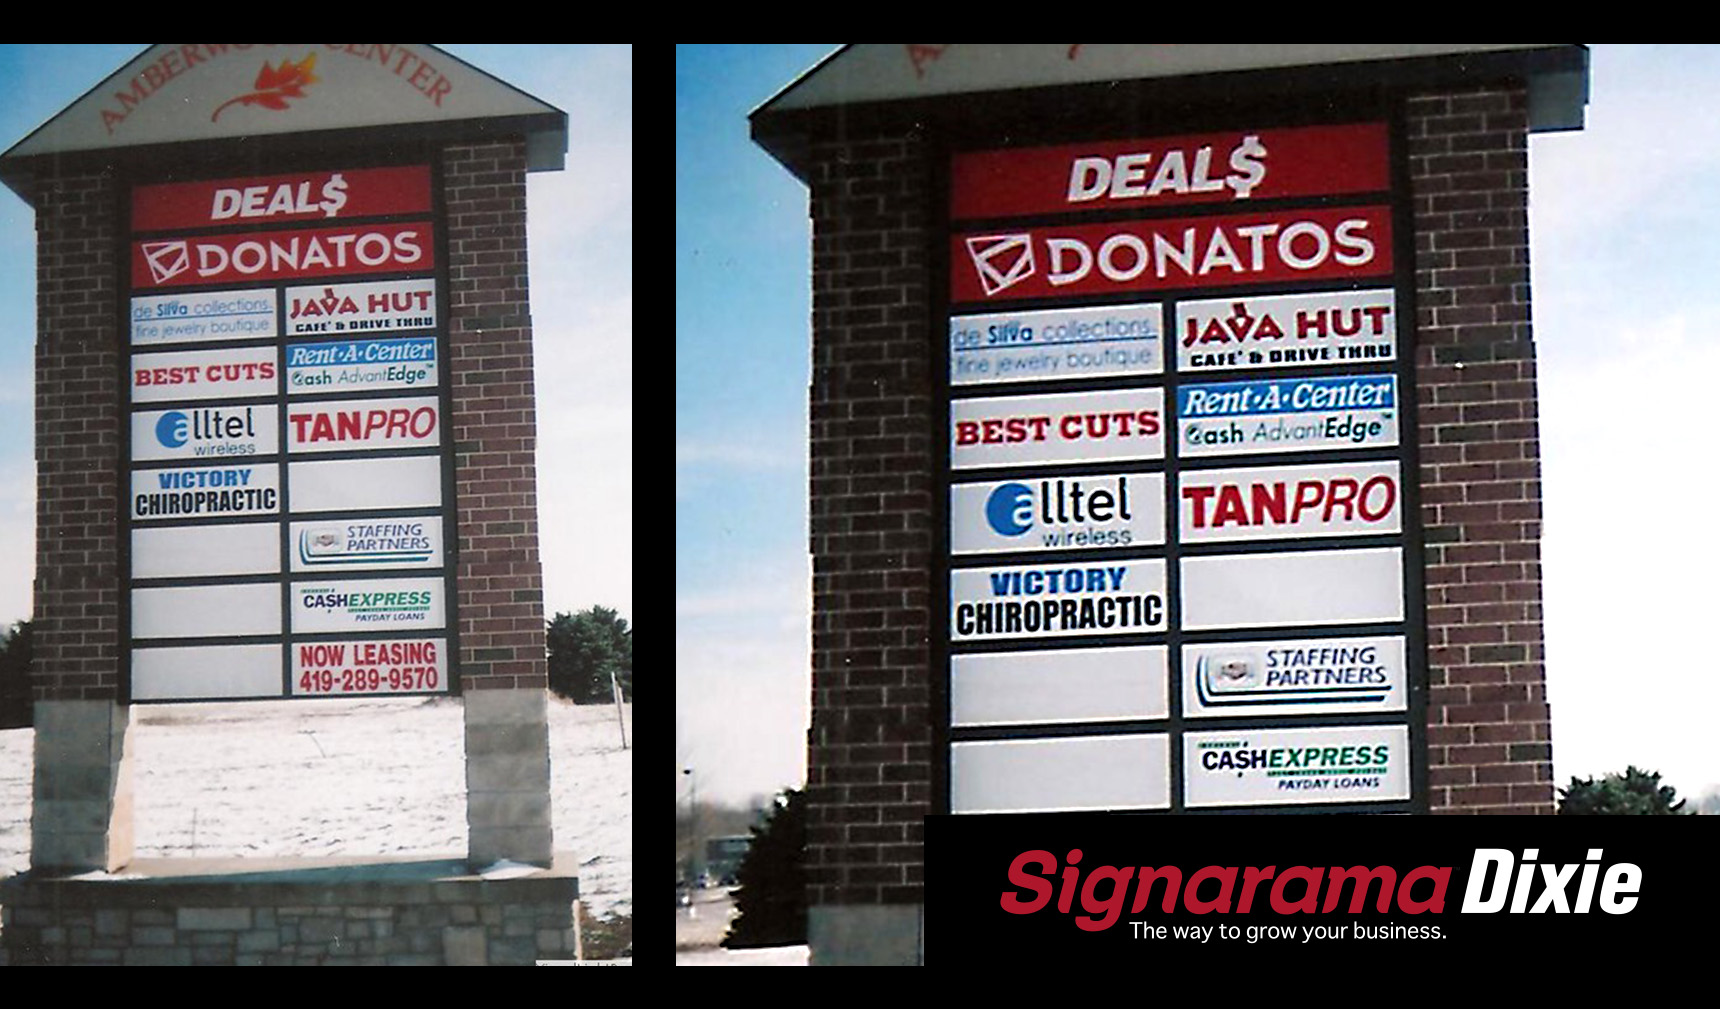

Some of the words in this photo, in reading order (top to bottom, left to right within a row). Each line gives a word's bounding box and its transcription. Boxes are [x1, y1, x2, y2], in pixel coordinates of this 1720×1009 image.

[325, 44, 452, 107] ENTER
[1068, 136, 1267, 201] DEAL$
[211, 174, 348, 219] DEAL$
[197, 231, 422, 276] DONATOS
[1046, 218, 1375, 286] DONATOS
[134, 305, 152, 318] de
[157, 302, 188, 317] Silva
[290, 288, 359, 319] JAVA
[367, 291, 432, 313] HUT
[136, 324, 158, 337] fine
[162, 321, 206, 339] jewelry
[211, 319, 269, 334] boutique
[335, 320, 345, 330] &
[349, 318, 391, 330] DRIVE
[397, 316, 433, 327] THRU
[953, 328, 980, 345] de
[988, 321, 1033, 343] Silva
[1183, 303, 1283, 348] JAVA
[1297, 307, 1390, 338] HUT
[957, 357, 989, 373] fine
[996, 353, 1059, 376] jewelry
[1066, 349, 1151, 369] boutique
[1249, 350, 1263, 363] &
[1270, 347, 1330, 363] DRIVE
[1338, 344, 1392, 359] THRU
[134, 366, 199, 387] BEST
[206, 362, 275, 381] CUTS
[173, 407, 255, 441] alltel
[956, 417, 1050, 446] BEST
[1060, 411, 1160, 438] CUTS
[194, 442, 256, 456] wireless
[158, 469, 252, 489] VICTORY
[136, 488, 276, 516] CHIROPRACTIC
[1012, 477, 1131, 525] alltel
[347, 523, 422, 538] STAFFING
[1042, 529, 1132, 547] wireless
[347, 537, 430, 551] PARTNERS
[990, 567, 1127, 596] VICTORY
[355, 613, 391, 622] PAYDAY
[393, 612, 425, 621] LOANS
[957, 595, 1162, 636] CHIROPRACTIC
[300, 644, 345, 667] NOW
[353, 642, 436, 666] LEASING
[1266, 646, 1375, 667] STAFFING
[300, 666, 438, 692] 419-289-9570
[1265, 665, 1386, 686] PARTNERS
[1278, 778, 1330, 790] PAYDAY
[1334, 777, 1380, 789] LOANS
